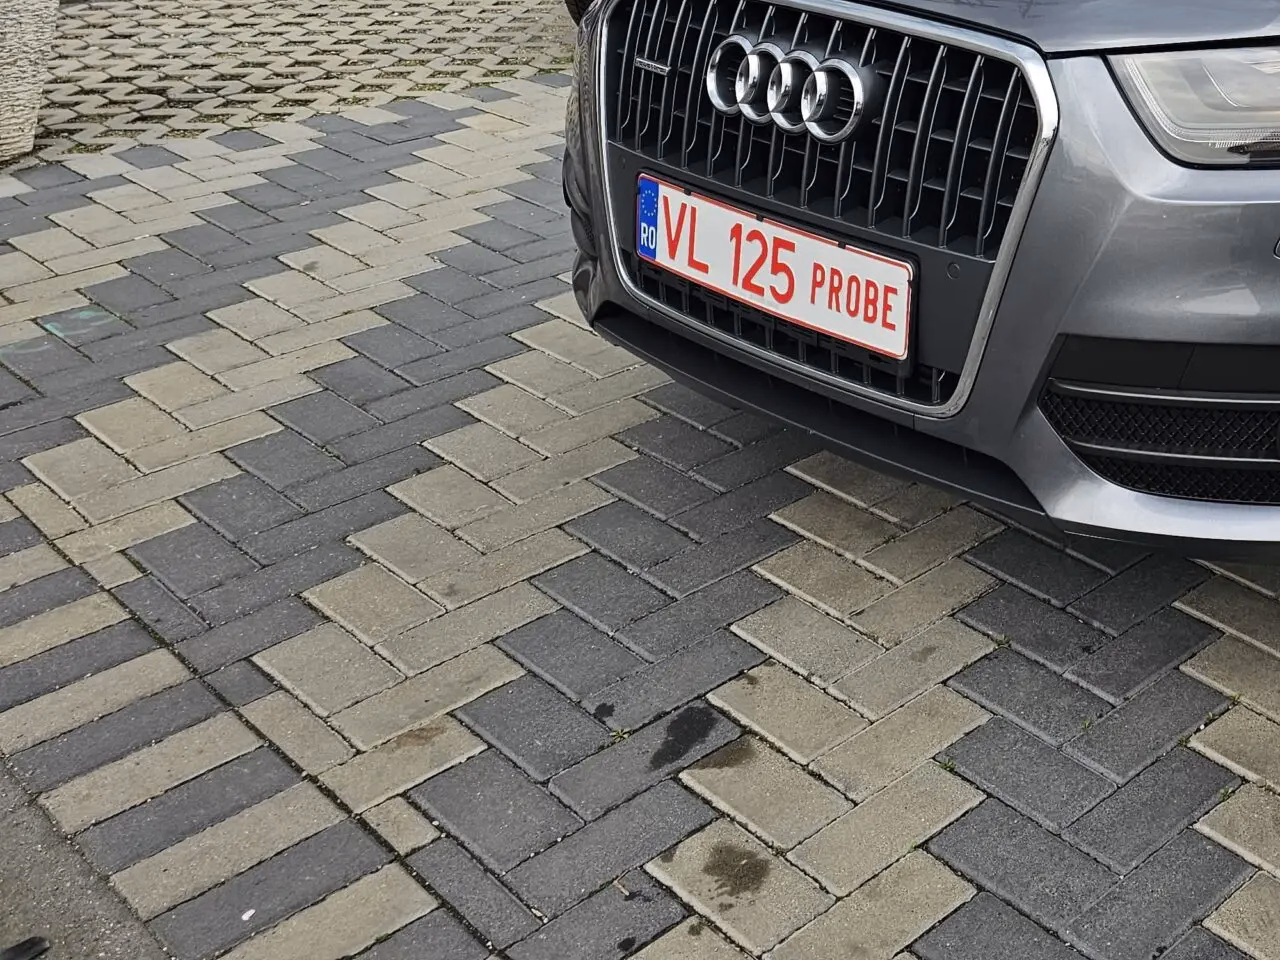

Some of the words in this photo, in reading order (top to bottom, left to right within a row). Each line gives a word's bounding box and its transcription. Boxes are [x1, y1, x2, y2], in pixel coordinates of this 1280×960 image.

[640, 222, 656, 250] RO
[662, 195, 709, 275] VL
[730, 222, 796, 305] 125
[810, 262, 898, 332] PROBE
